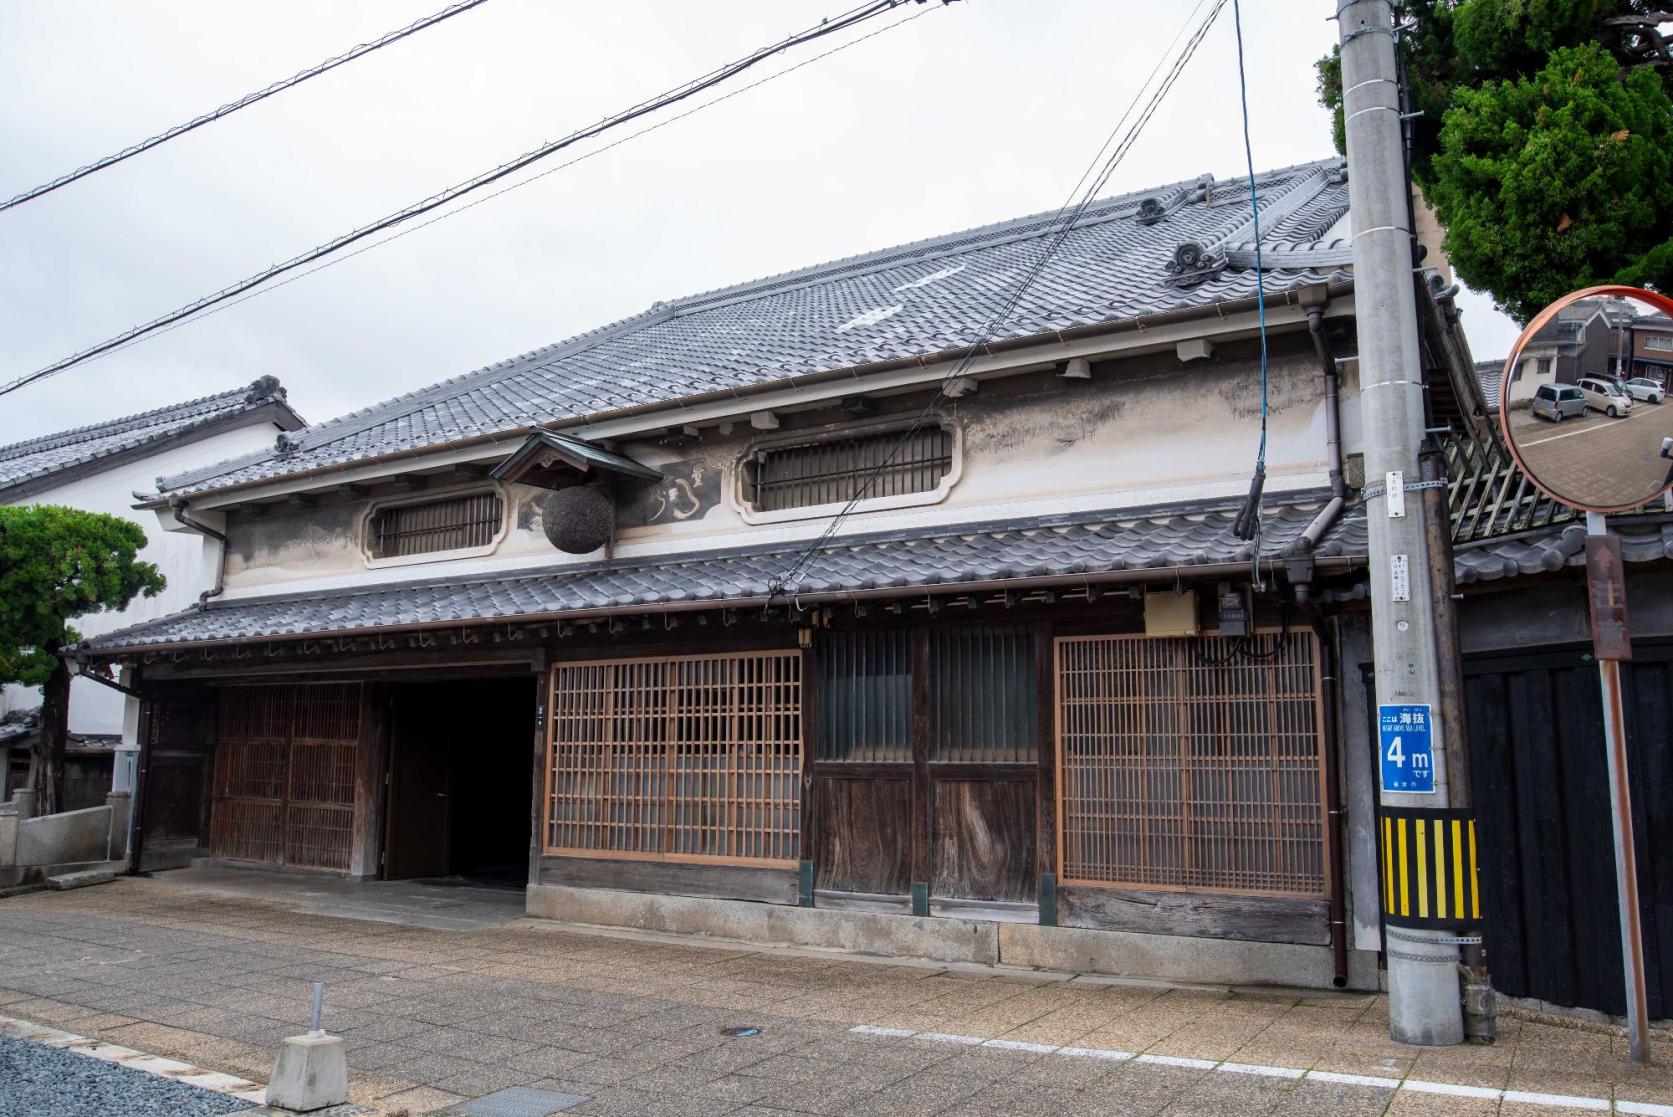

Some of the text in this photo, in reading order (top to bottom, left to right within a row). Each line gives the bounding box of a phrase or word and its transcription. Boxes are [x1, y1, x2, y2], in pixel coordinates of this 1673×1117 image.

[1387, 736, 1429, 768] 4 m
[1412, 770, 1430, 778] です
